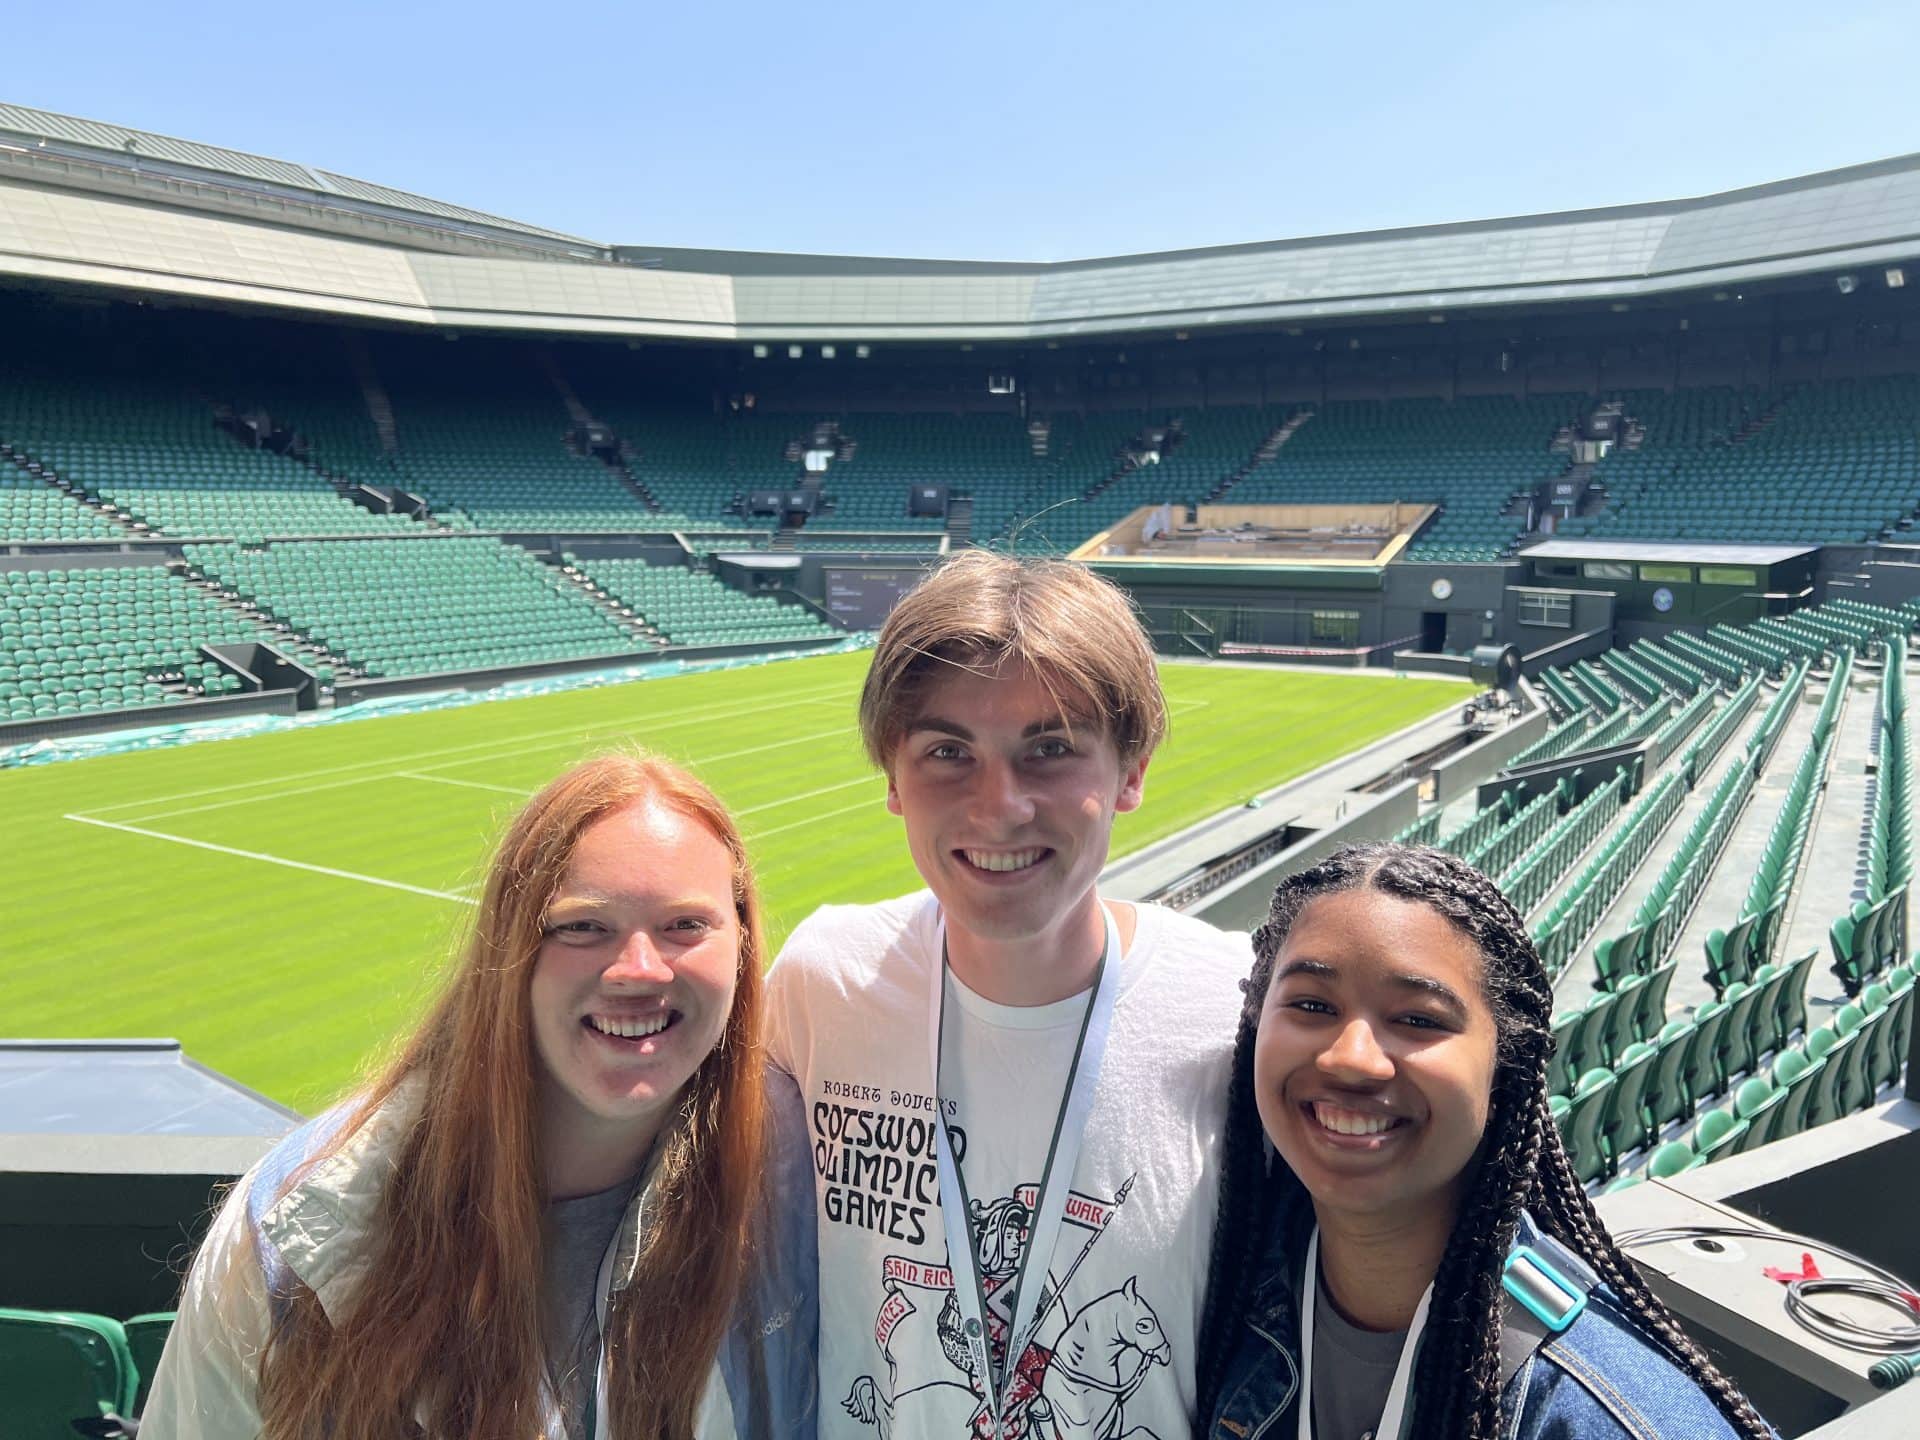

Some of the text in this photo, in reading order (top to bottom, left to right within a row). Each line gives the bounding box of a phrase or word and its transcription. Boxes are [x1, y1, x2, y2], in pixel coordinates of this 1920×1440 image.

[823, 1080, 881, 1102] ROBERT
[815, 1139, 943, 1207] OLIMPIC
[825, 1186, 926, 1245] GAMES
[1066, 1198, 1103, 1224] WAR
[876, 1296, 906, 1344] RACES
